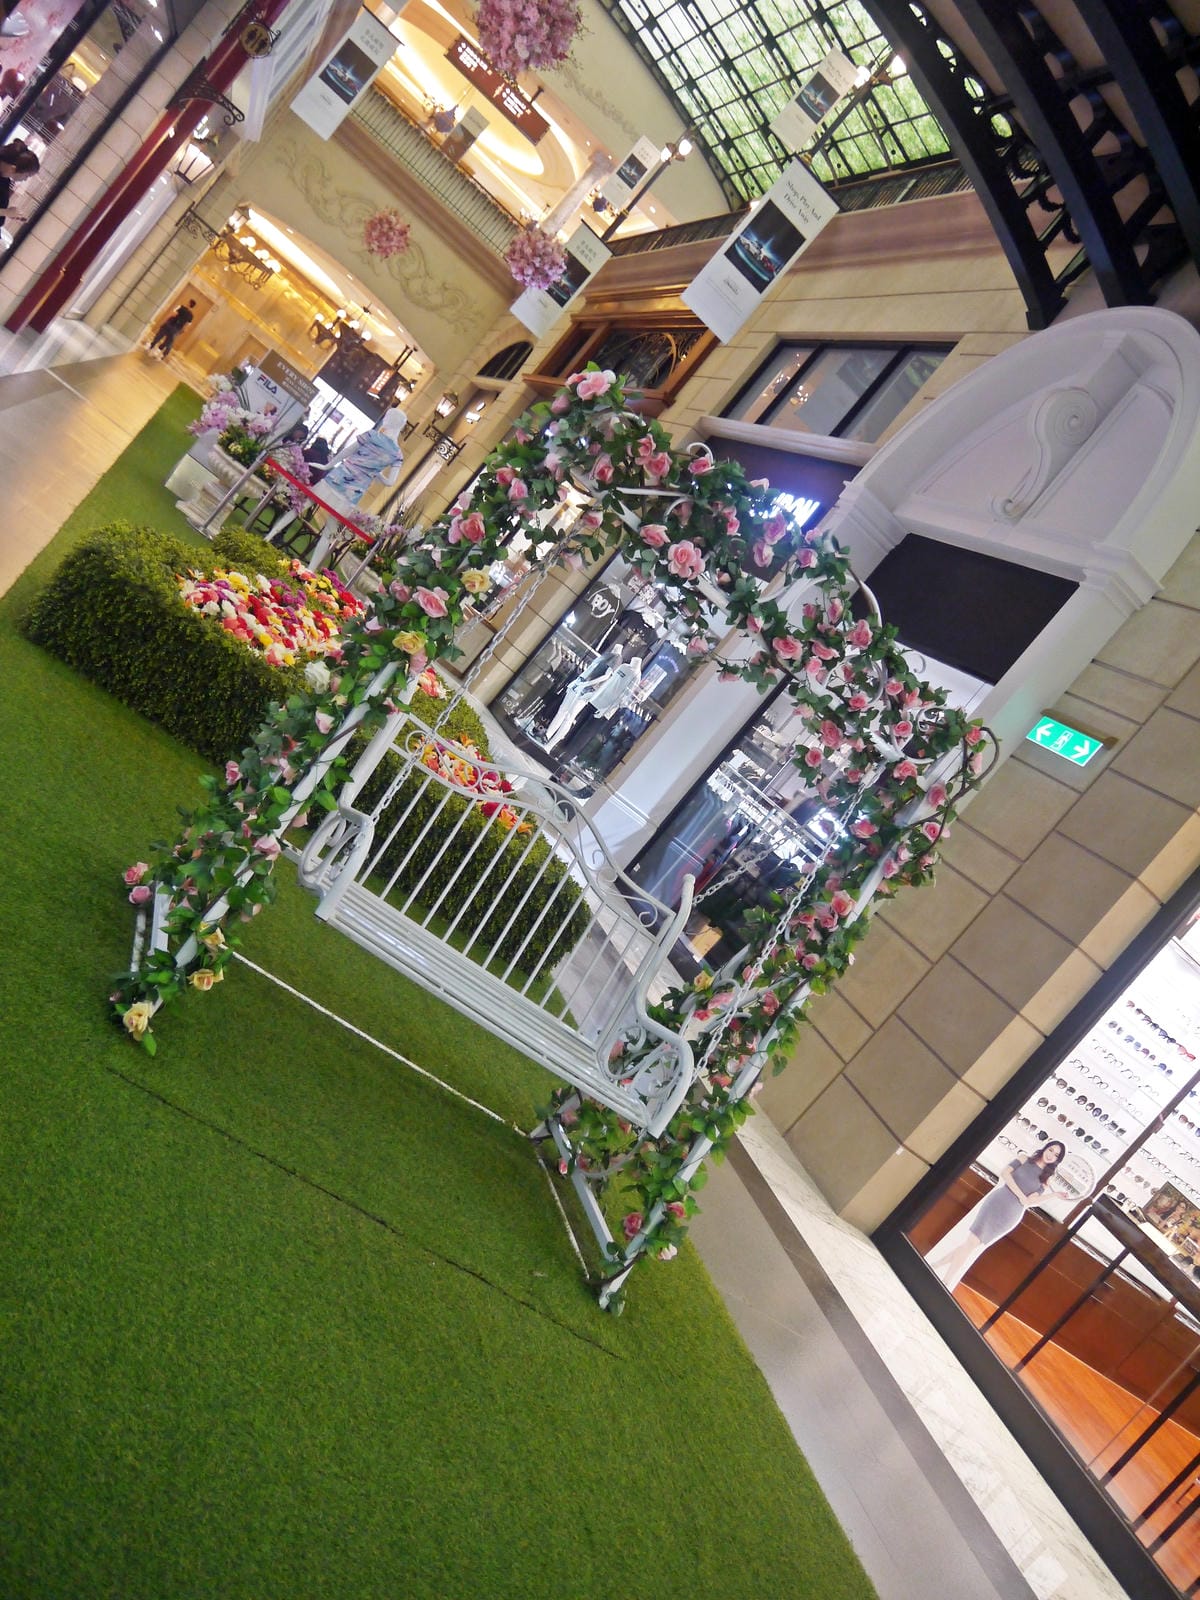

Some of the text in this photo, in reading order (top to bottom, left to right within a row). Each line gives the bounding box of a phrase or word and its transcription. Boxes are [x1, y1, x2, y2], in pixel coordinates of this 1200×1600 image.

[782, 192, 809, 224] Drive Away
[798, 195, 811, 209] Play
[808, 206, 822, 221] And
[256, 373, 277, 395] FILA
[277, 361, 298, 381] EVERY
[590, 592, 615, 618] BOY
